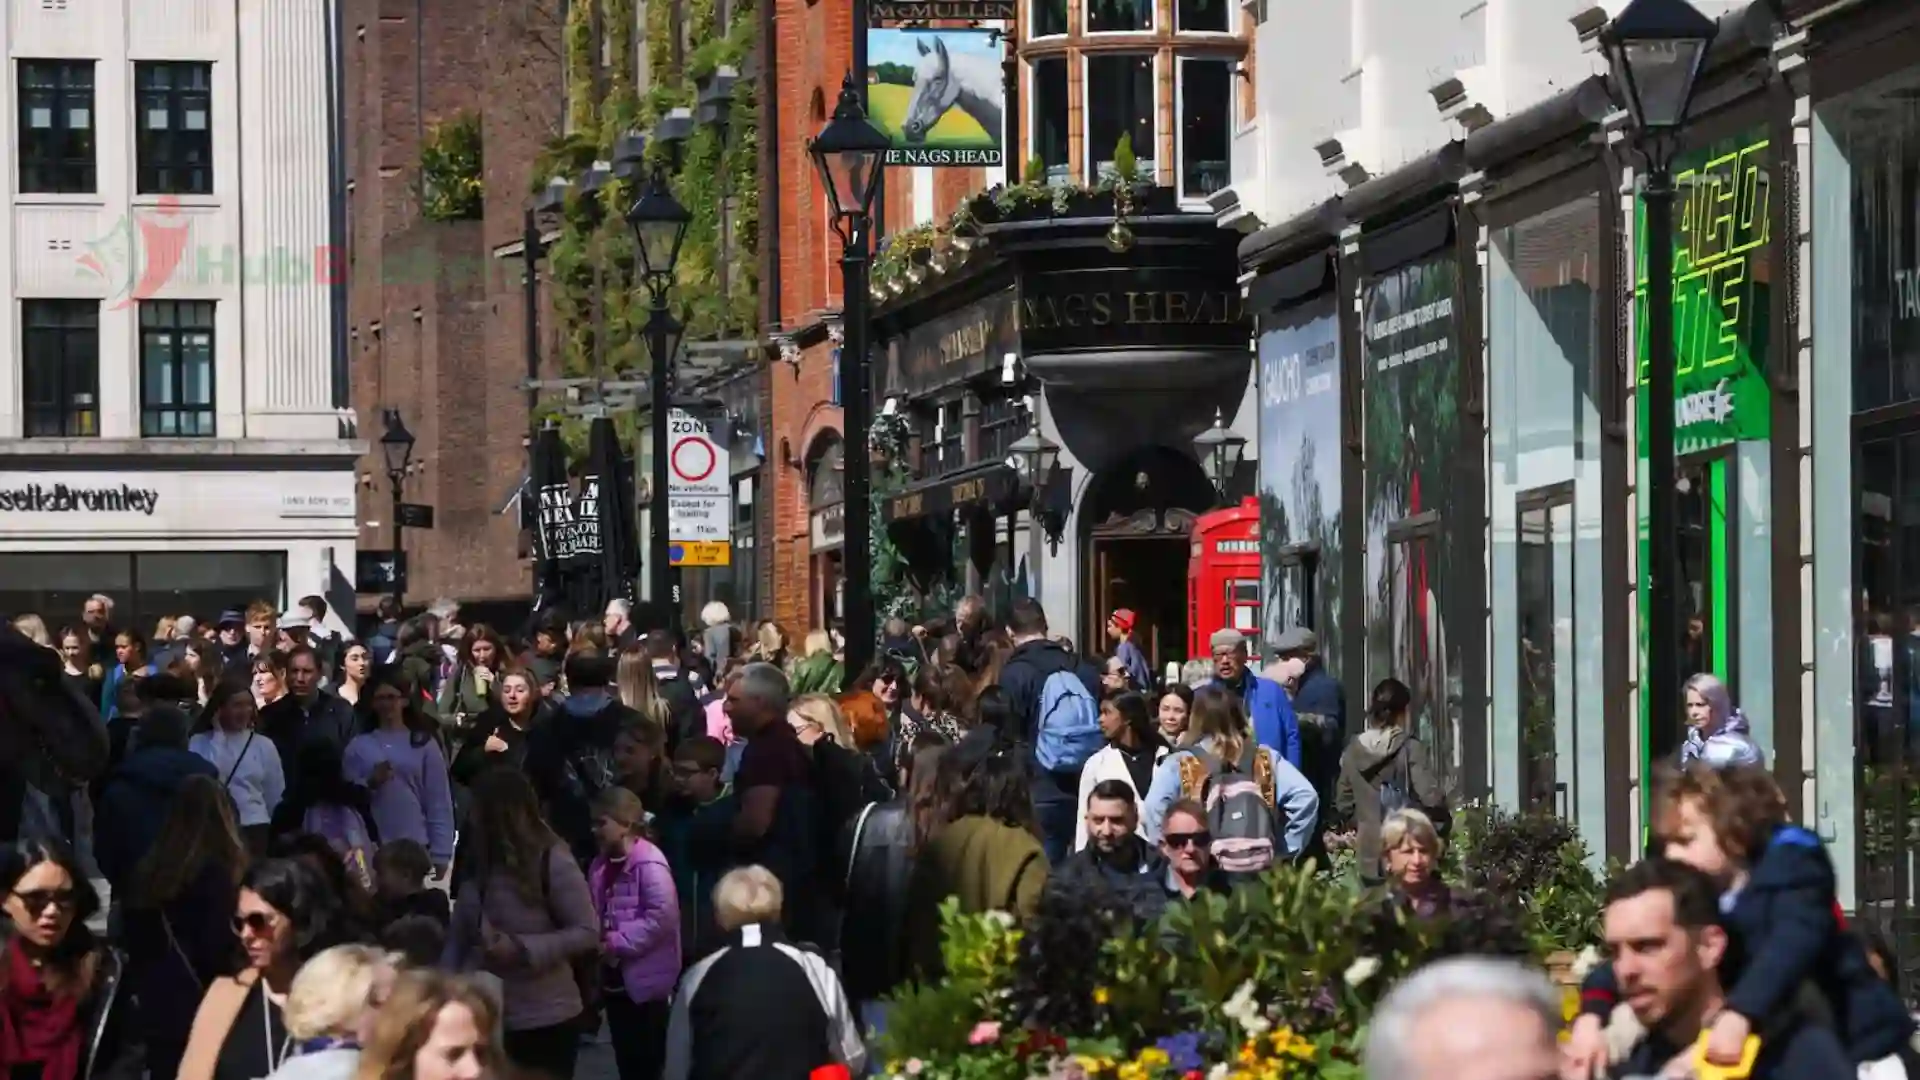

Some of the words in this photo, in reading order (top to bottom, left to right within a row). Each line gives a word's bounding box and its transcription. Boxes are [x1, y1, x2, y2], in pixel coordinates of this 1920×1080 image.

[904, 149, 951, 164] NAGS
[953, 149, 1001, 164] HEAD
[1123, 290, 1244, 325] HEAD
[672, 421, 714, 433] ZONE
